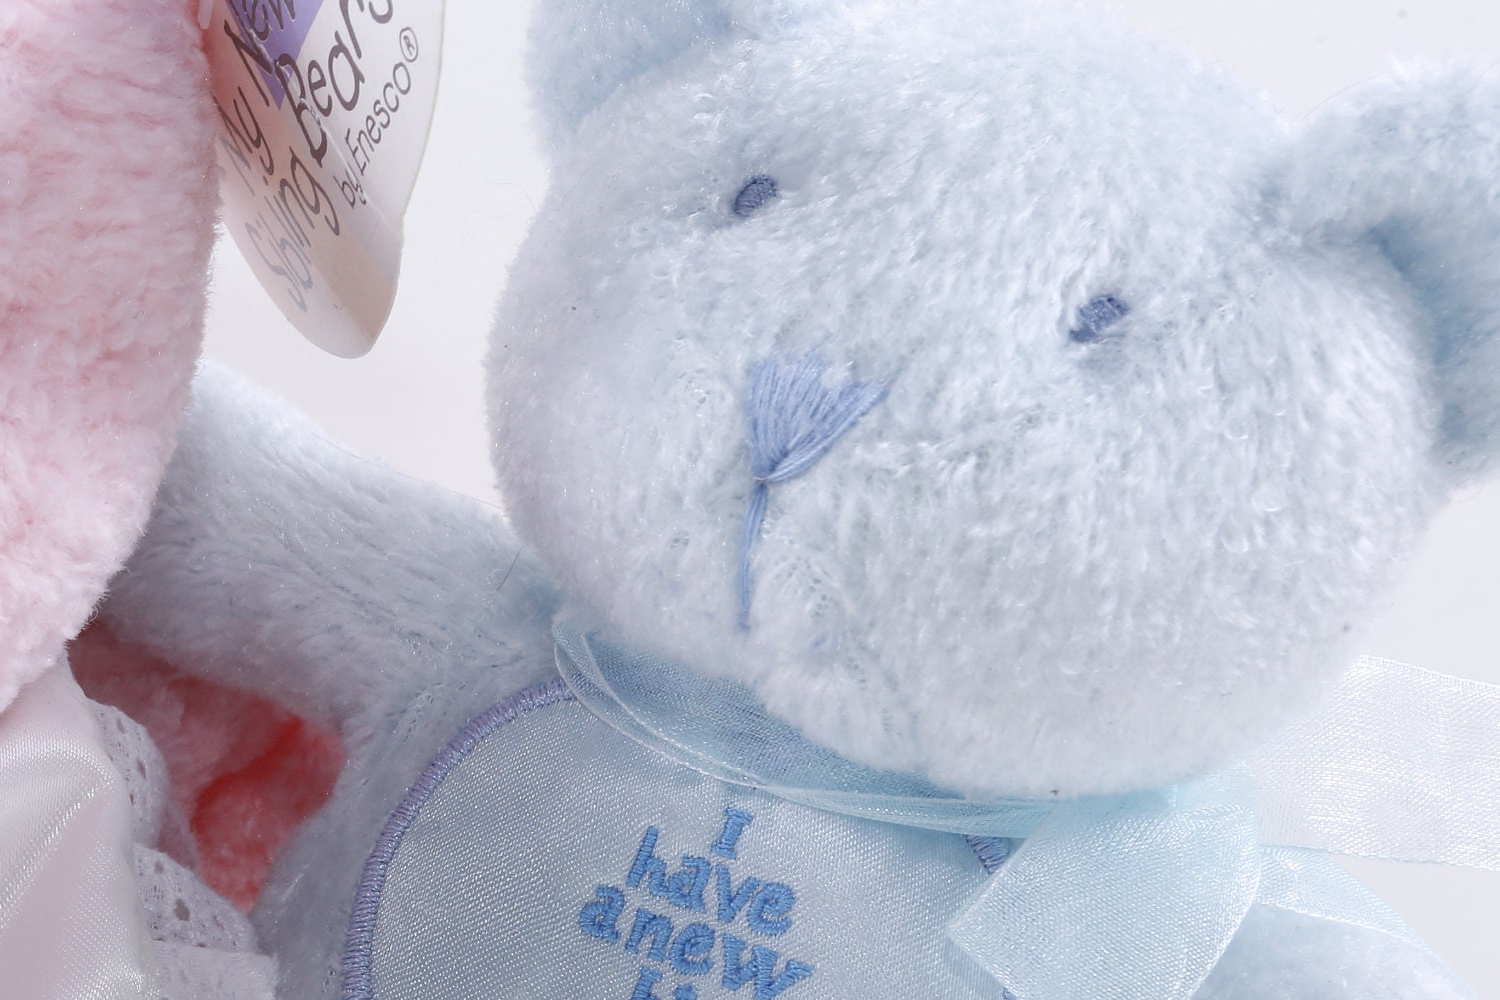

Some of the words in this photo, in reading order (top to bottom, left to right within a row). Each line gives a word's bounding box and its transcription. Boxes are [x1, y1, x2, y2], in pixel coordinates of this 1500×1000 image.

[245, 146, 340, 312] Sibling
[625, 826, 795, 936] have
[711, 806, 754, 860] I
